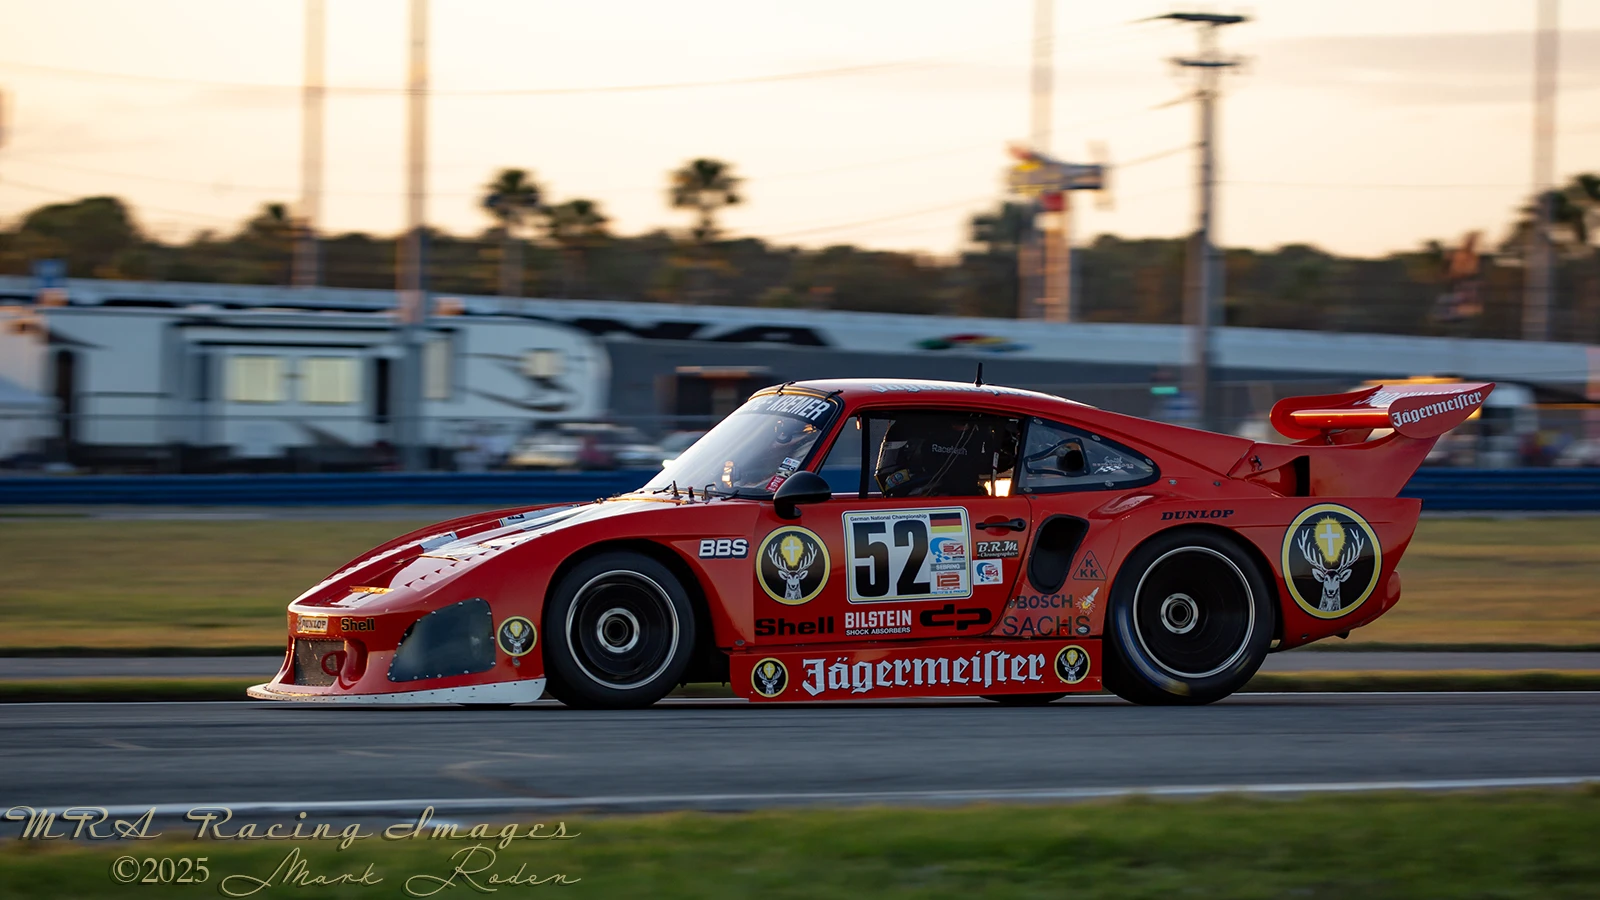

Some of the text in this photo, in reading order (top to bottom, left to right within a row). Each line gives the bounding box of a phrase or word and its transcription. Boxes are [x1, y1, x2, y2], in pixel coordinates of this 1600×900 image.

[1160, 509, 1235, 521] DUNLOP
[698, 538, 749, 559] BBS
[976, 540, 1018, 553] B.R.M
[852, 519, 931, 597] 52
[935, 563, 961, 571] SEBRING
[1016, 594, 1073, 609] BOSCH
[341, 618, 375, 631] Shell
[755, 616, 834, 636] Shell
[844, 609, 912, 629] BILSTEIN
[1002, 615, 1092, 637] SACHS
[871, 626, 911, 635] ABSORBERS
